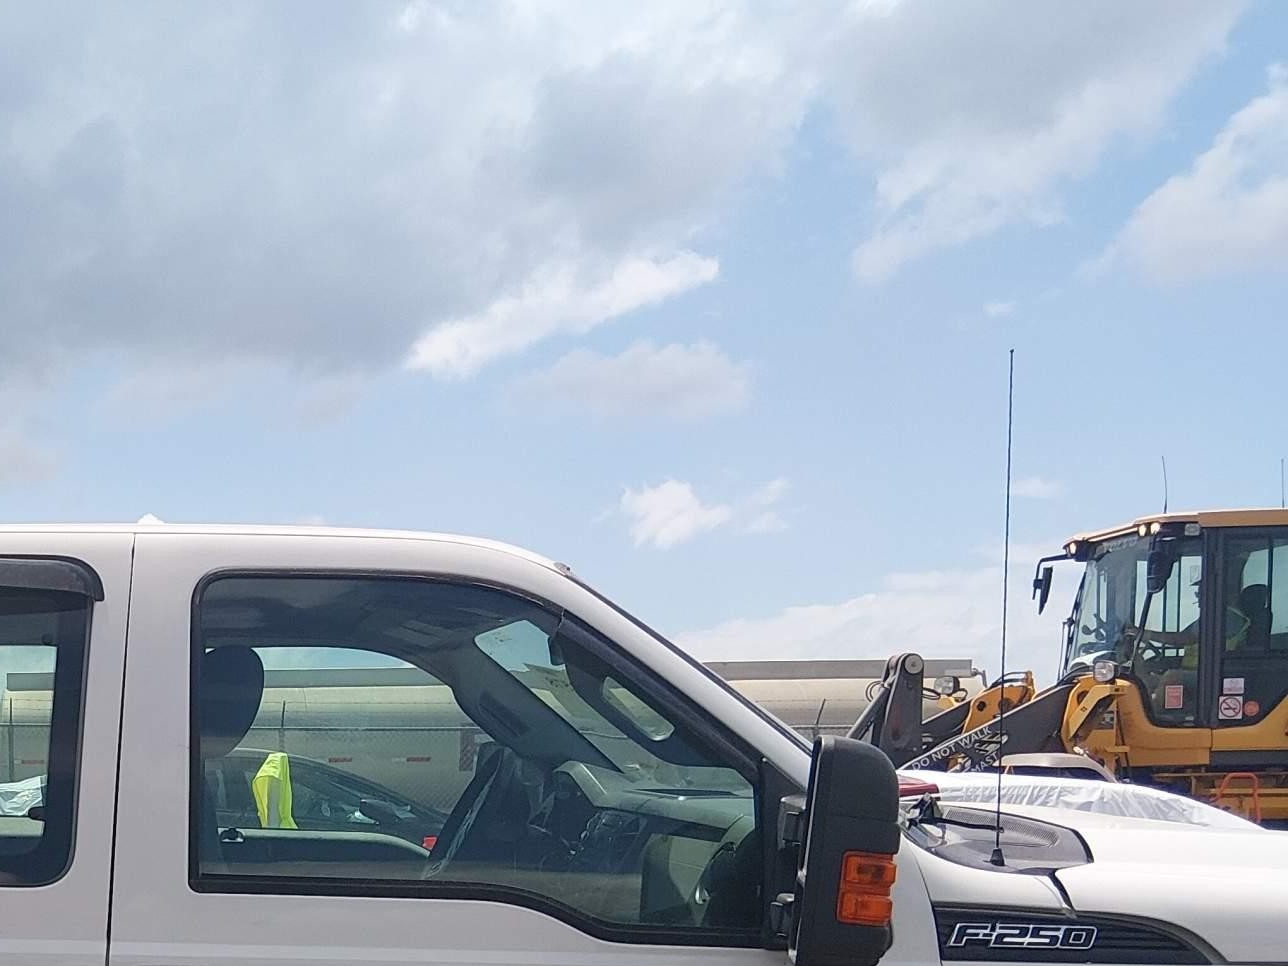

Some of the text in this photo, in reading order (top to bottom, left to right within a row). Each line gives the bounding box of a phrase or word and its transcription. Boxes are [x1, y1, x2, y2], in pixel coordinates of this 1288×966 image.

[912, 726, 992, 771] DO NOT WALK
[947, 921, 1098, 950] F-250
